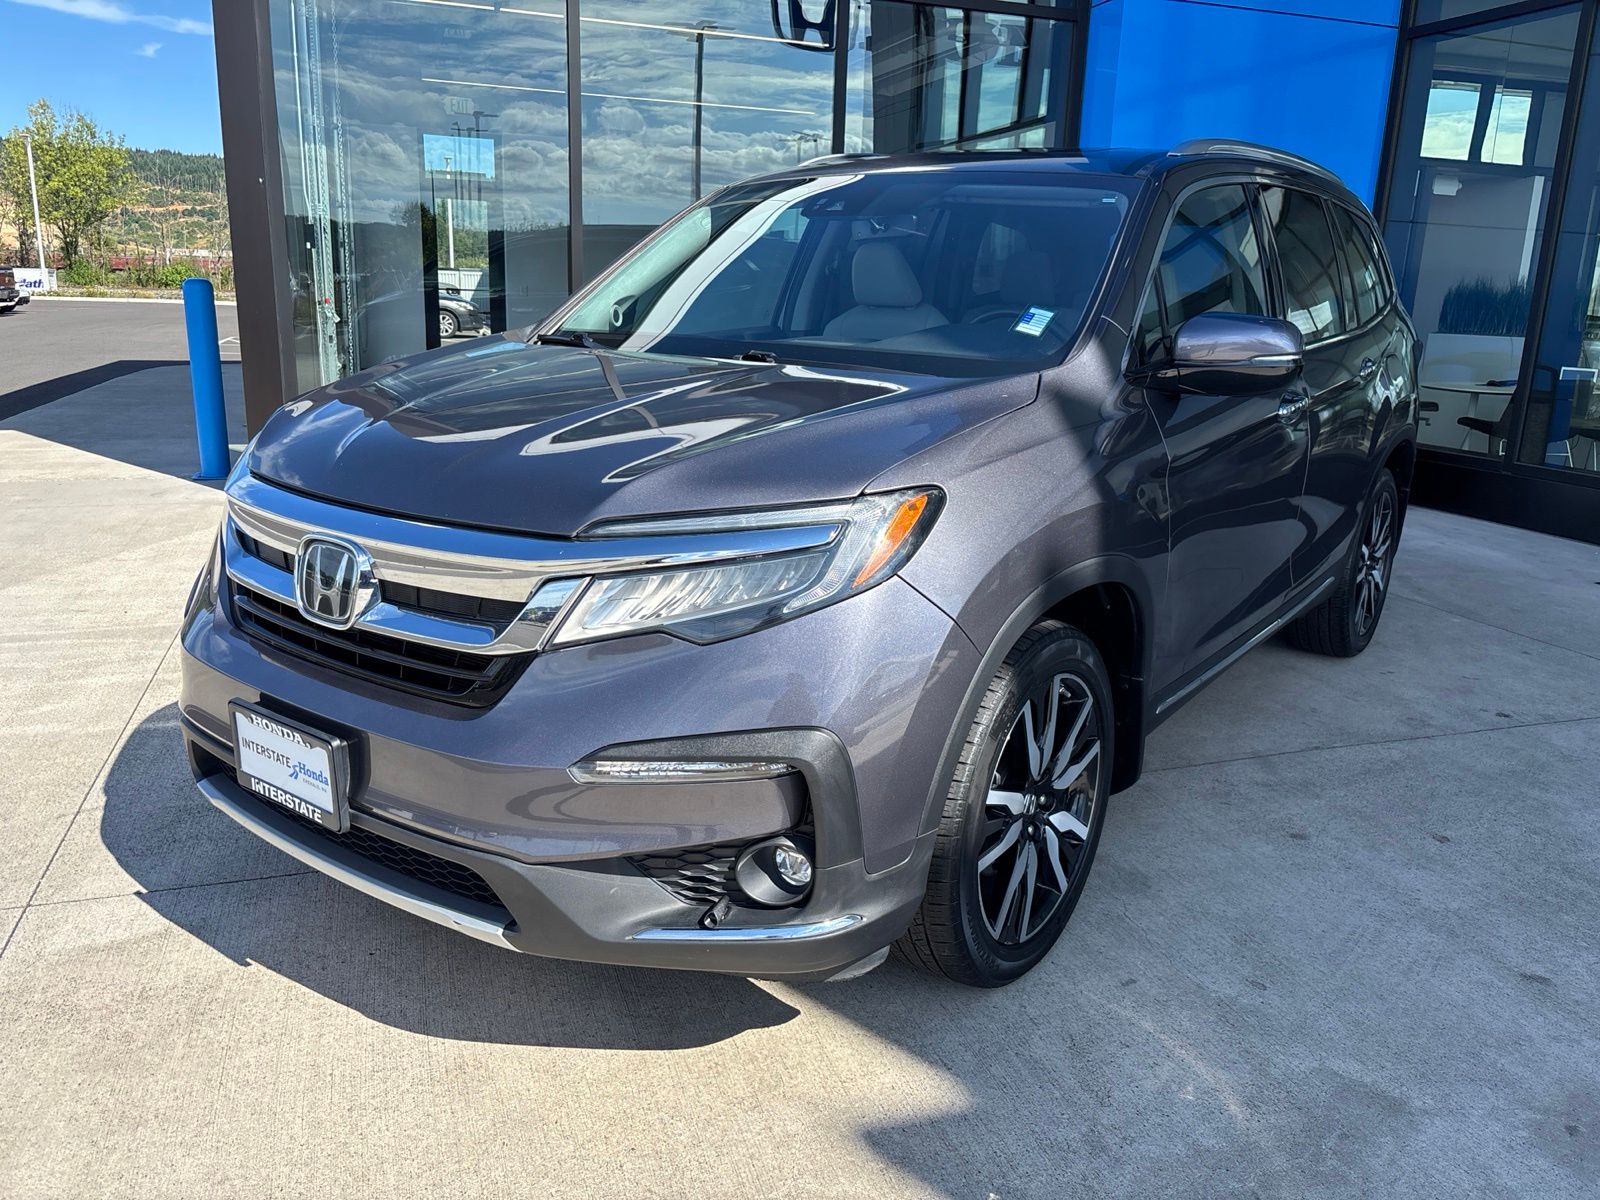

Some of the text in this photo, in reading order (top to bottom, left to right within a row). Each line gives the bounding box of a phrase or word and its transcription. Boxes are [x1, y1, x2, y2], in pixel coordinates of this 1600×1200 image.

[450, 98, 470, 113] EXIT
[250, 714, 306, 747] HONDA
[241, 736, 292, 769] INTERSTATE
[297, 761, 329, 786] Honda
[251, 777, 323, 824] INTERSTATE
